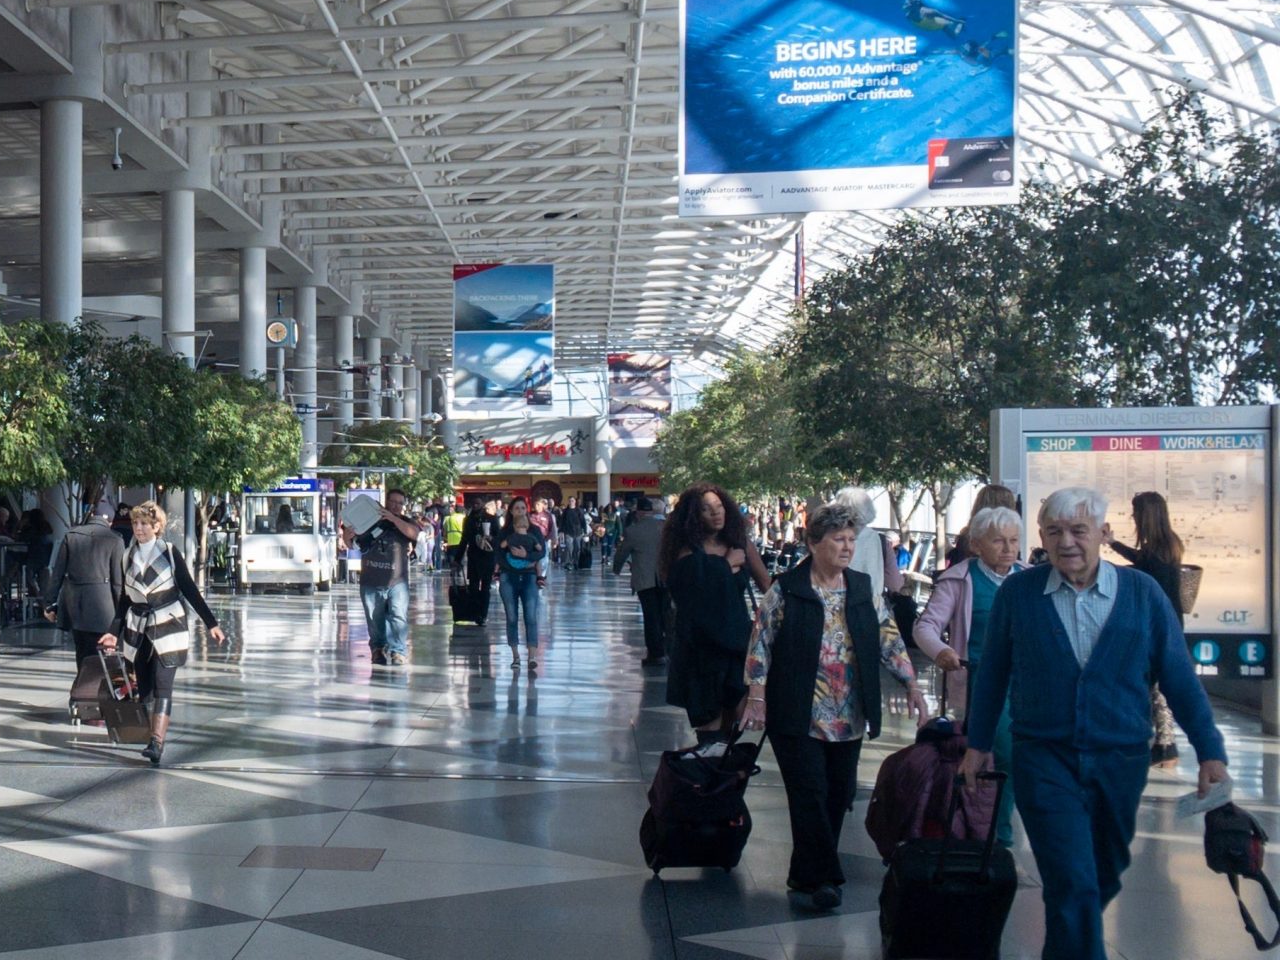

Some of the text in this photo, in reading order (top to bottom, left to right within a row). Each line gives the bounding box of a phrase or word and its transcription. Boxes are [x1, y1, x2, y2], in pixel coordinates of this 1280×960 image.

[776, 36, 917, 62] BEGINS HERE
[769, 66, 797, 79] with
[798, 64, 842, 78] 60,000
[793, 75, 898, 91] bonus miles and a
[777, 88, 914, 106] Companion Certificate.
[1055, 411, 1233, 427] TERMINAL DIRECTORY
[1040, 438, 1077, 451] SHOP
[1109, 437, 1143, 451] DINE
[1223, 610, 1249, 622] CLT
[1200, 642, 1257, 662] D E
